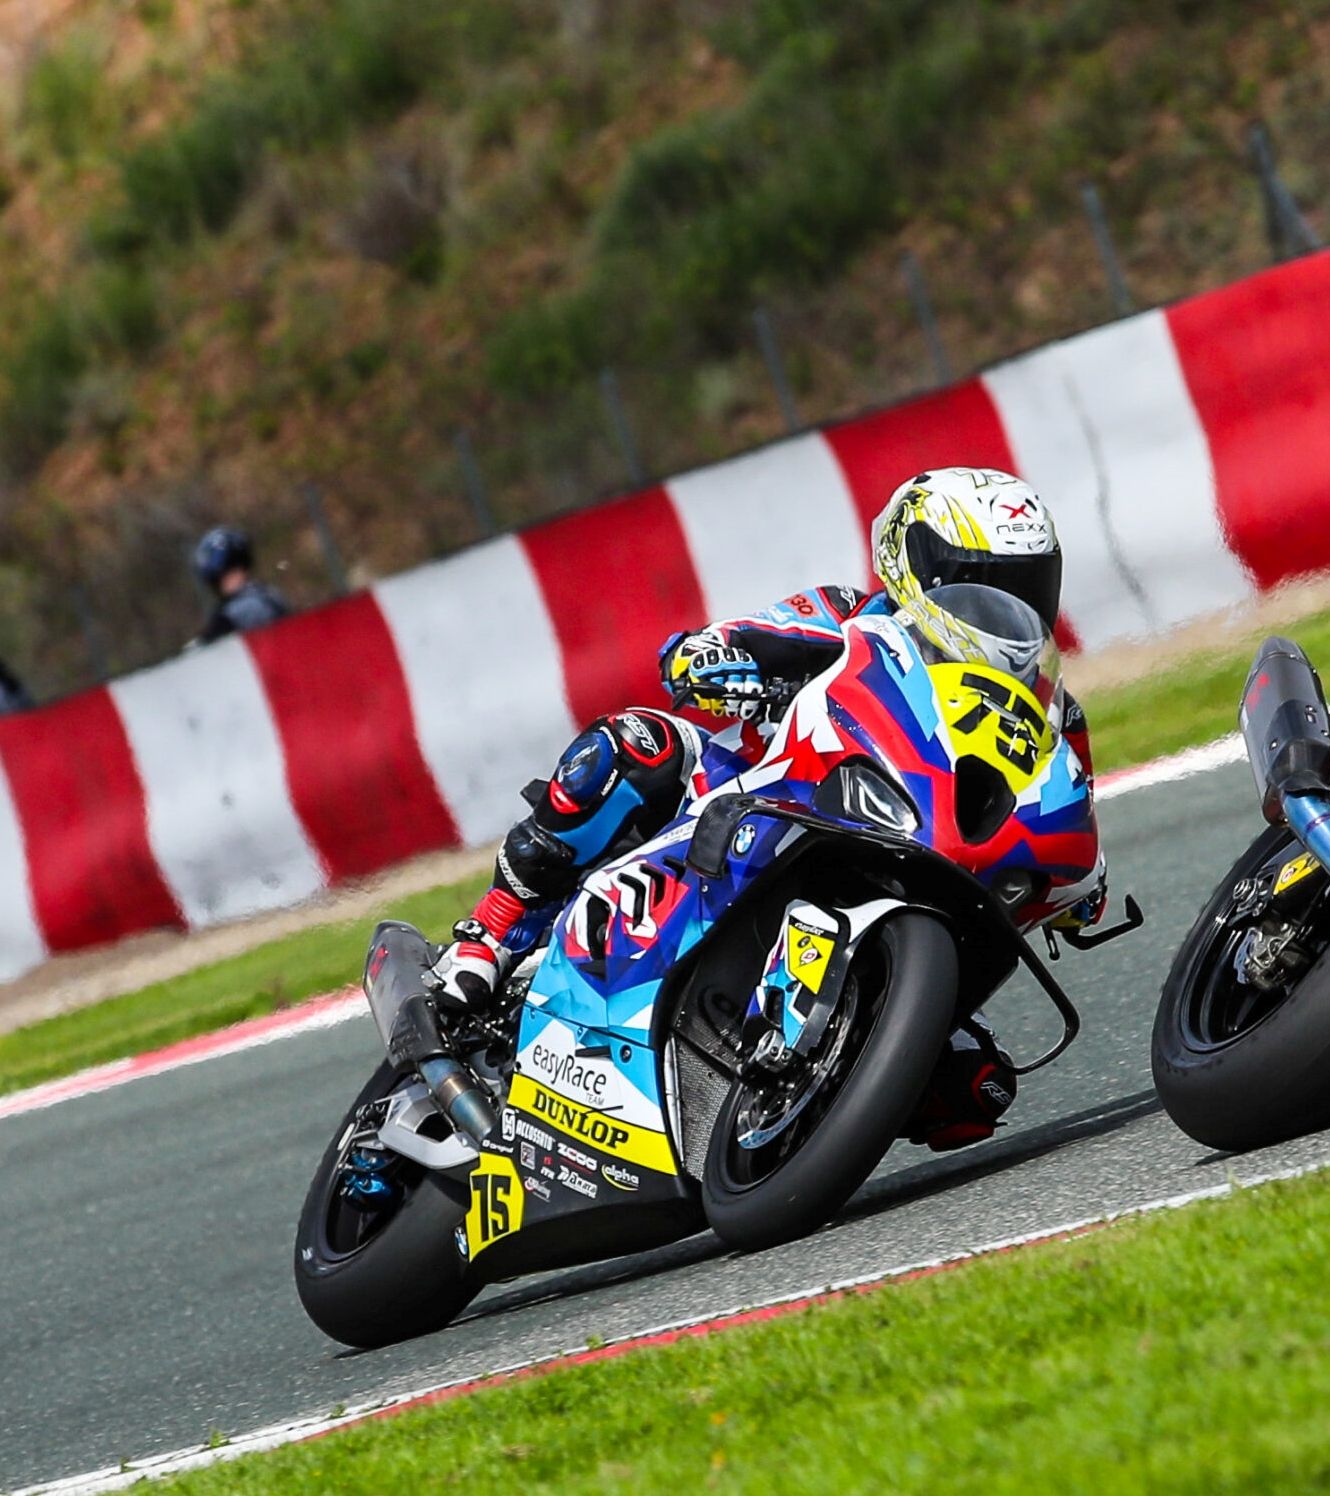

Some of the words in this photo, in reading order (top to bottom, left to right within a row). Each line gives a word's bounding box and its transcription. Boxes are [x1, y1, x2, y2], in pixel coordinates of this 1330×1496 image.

[996, 522, 1048, 535] NEXX
[952, 672, 1046, 776] 75
[532, 1044, 607, 1096] easyRace
[532, 1088, 629, 1150] DUNLOP
[585, 1093, 605, 1106] TEAM
[604, 1165, 640, 1185] alpha
[471, 1174, 512, 1242] 75
